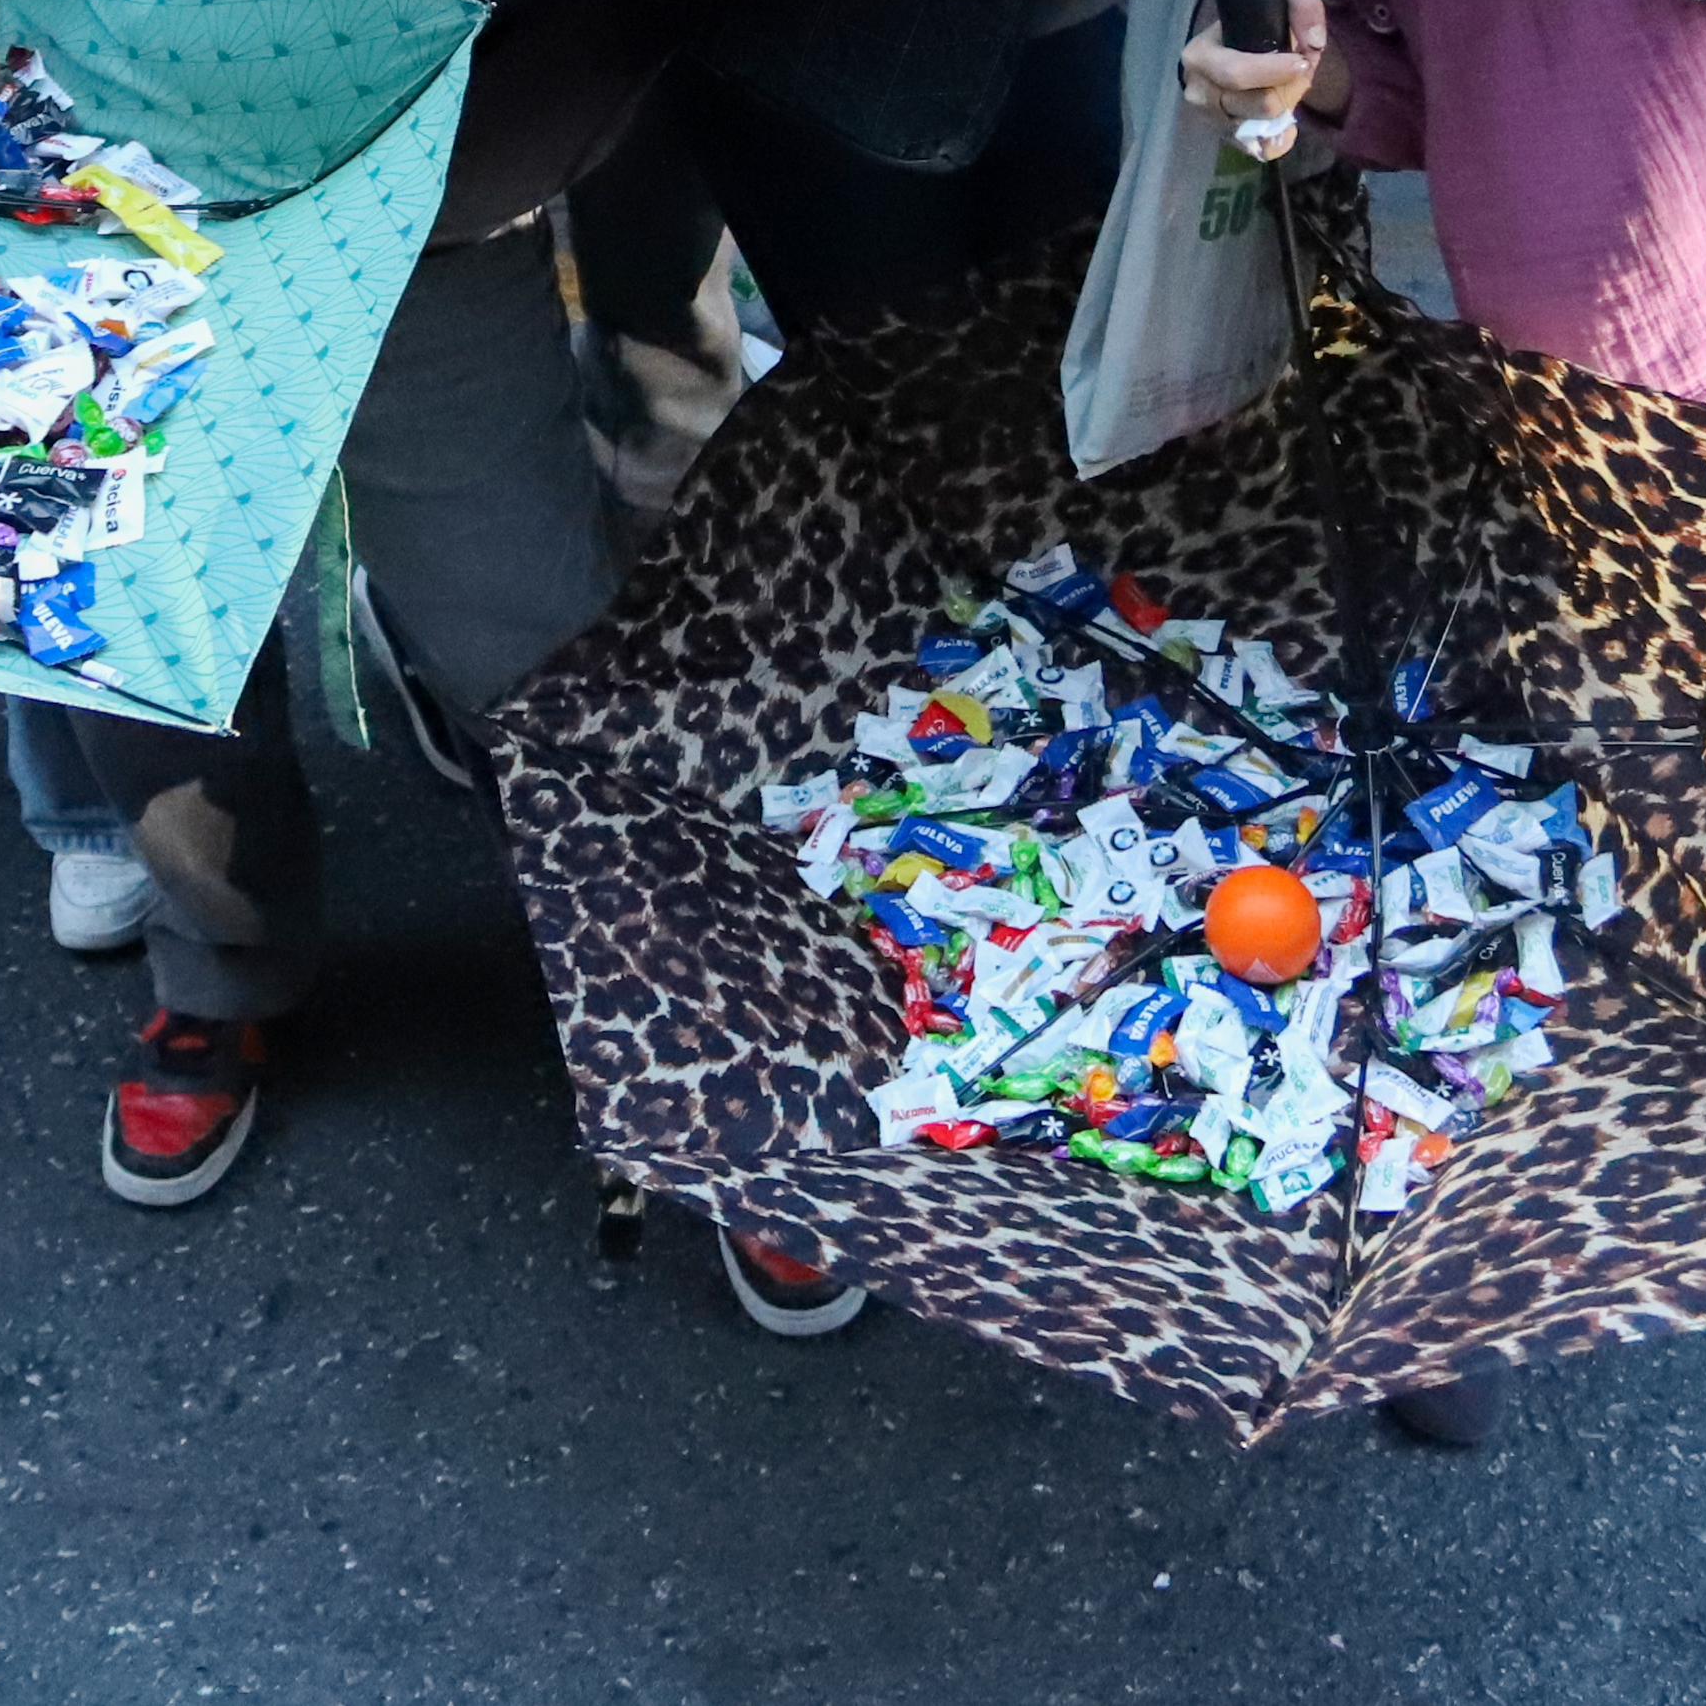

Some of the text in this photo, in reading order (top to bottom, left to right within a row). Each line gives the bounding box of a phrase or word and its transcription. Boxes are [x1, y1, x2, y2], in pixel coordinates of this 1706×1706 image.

[106, 484, 121, 534] acisa
[1428, 780, 1482, 824] PULEVA
[1129, 992, 1173, 1041] PULEVA
[1266, 1141, 1320, 1167] MUCESA
